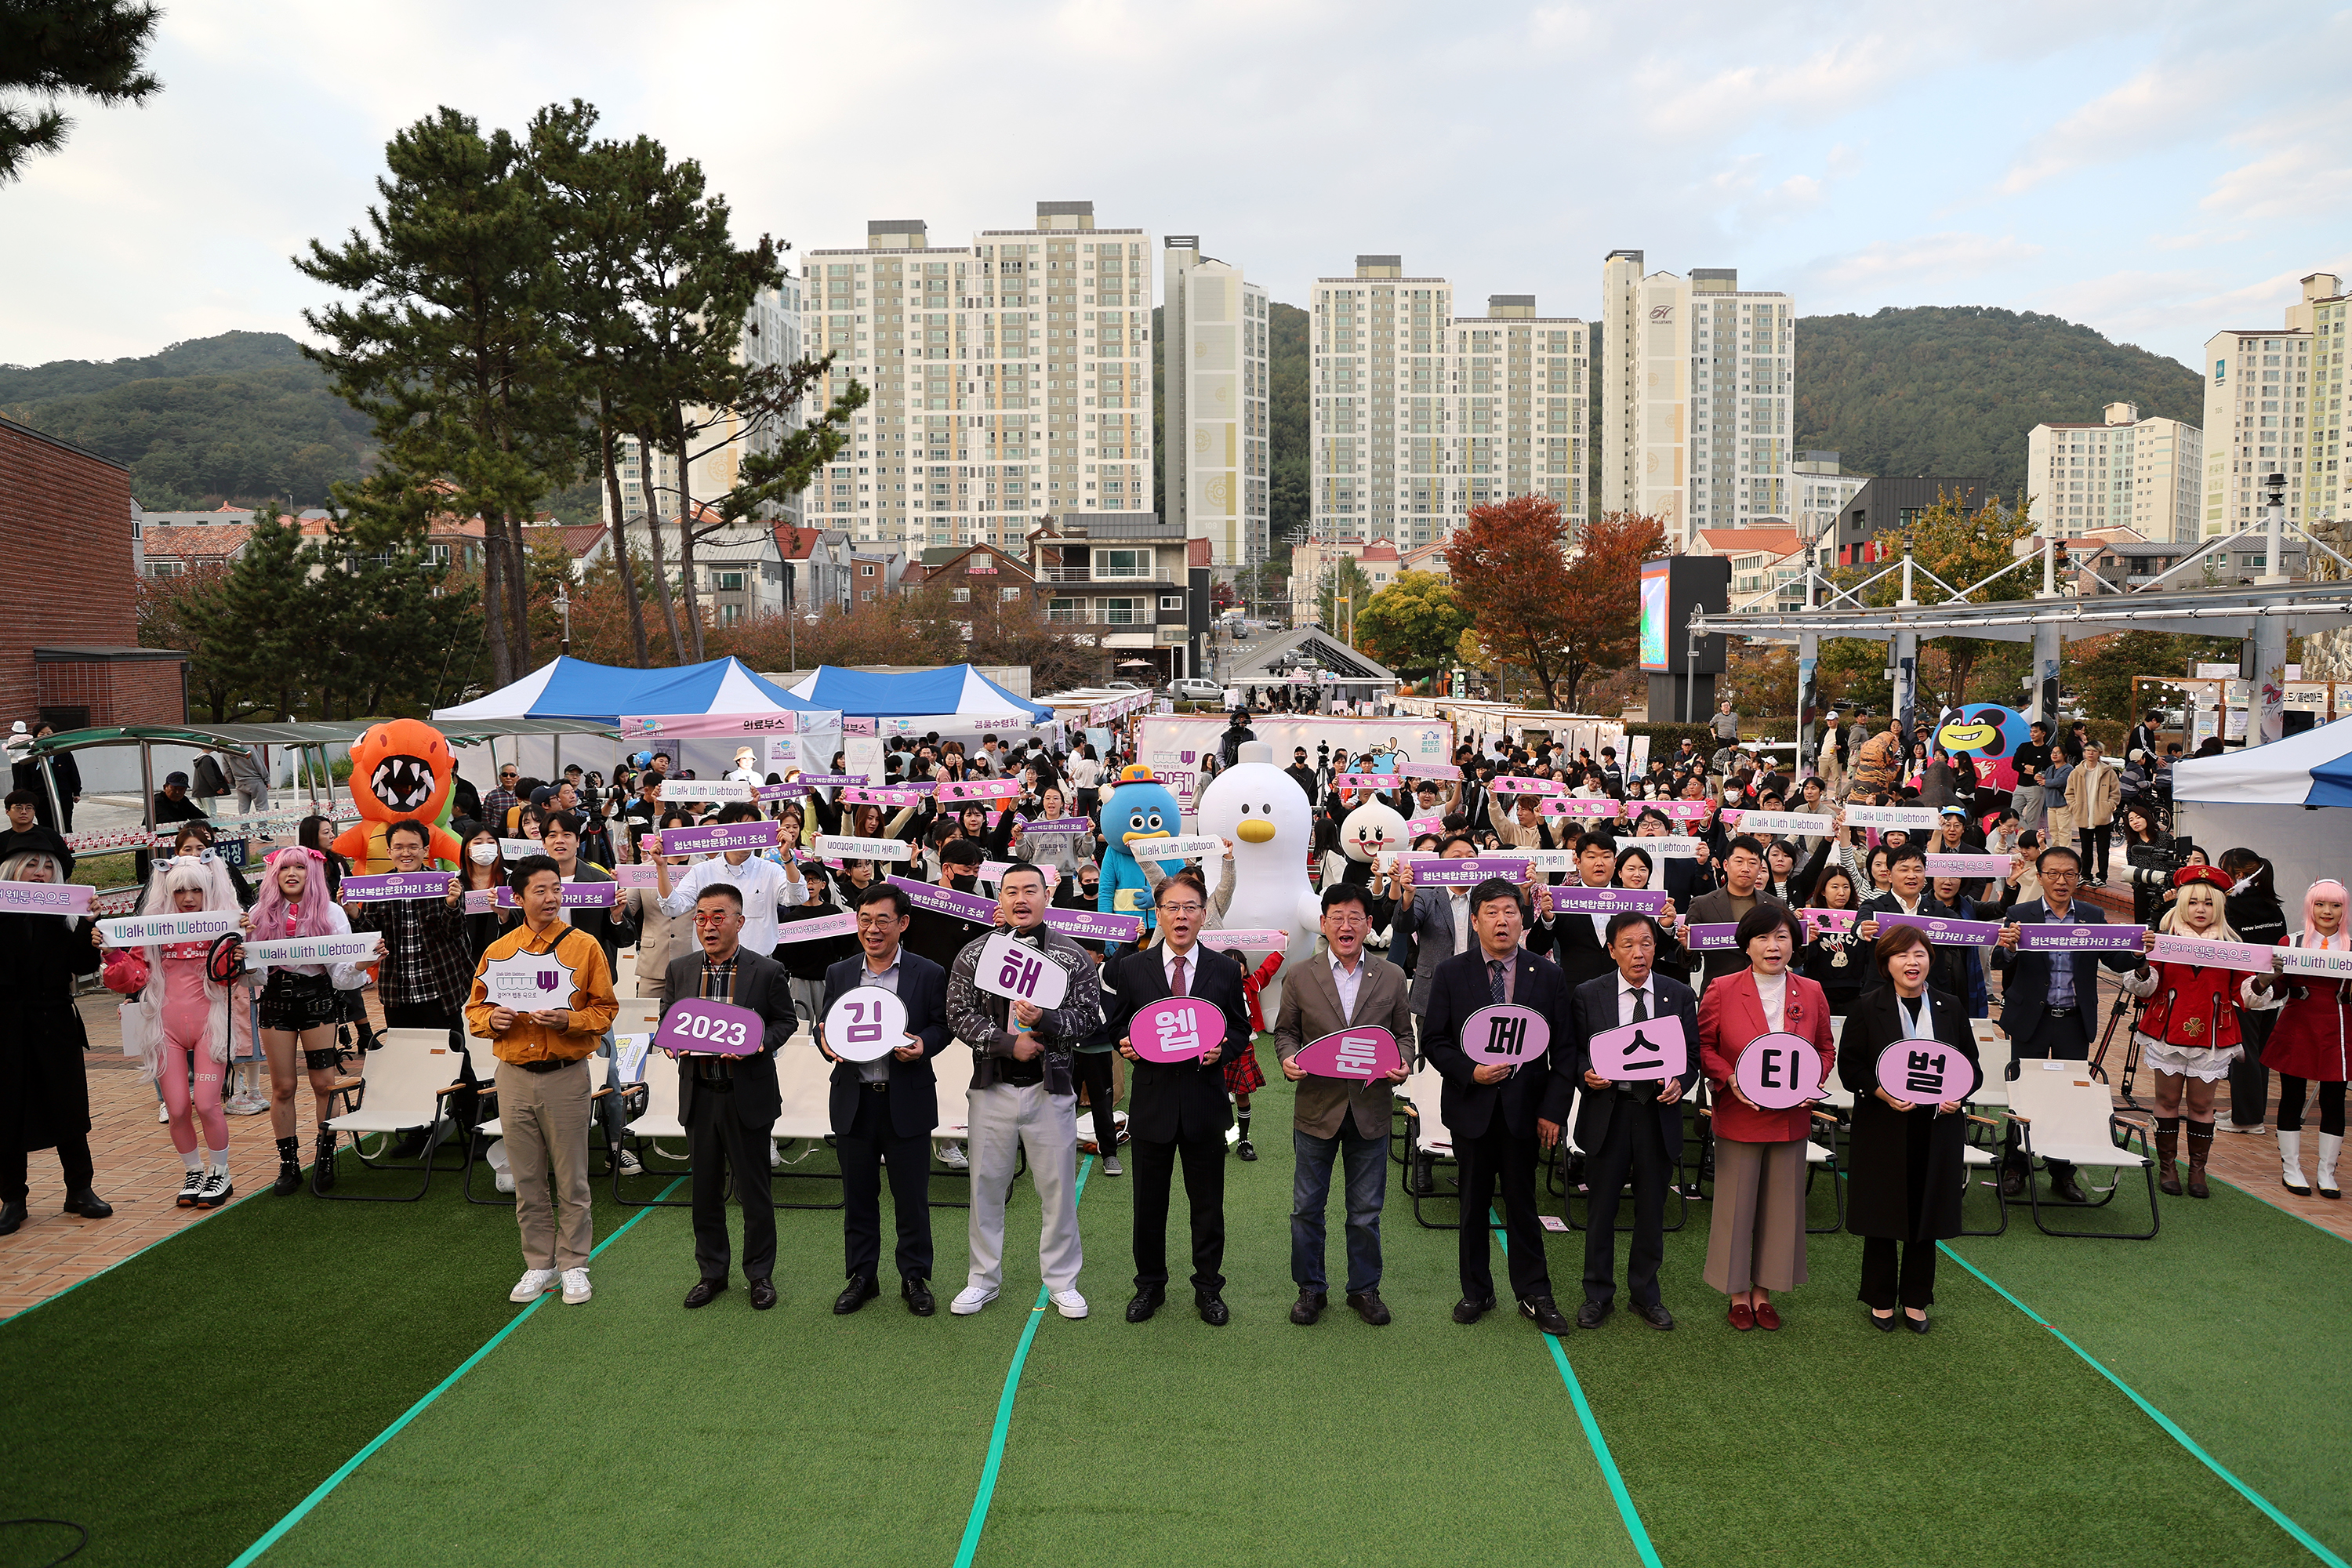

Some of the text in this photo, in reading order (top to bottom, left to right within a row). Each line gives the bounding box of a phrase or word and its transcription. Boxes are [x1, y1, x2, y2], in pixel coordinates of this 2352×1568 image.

[743, 719, 786, 730] 의료부스
[975, 718, 1018, 729] 경품수령처
[1132, 771, 1145, 779] W
[669, 786, 742, 797] Walk With Webtoon
[760, 789, 791, 799] 복합문화거리
[1749, 817, 1824, 830] Walk With Webtoon
[1855, 811, 1930, 823] Walk With Webtoon
[673, 833, 768, 850] 청년복합문화거리 조성
[827, 840, 901, 855] Walk With Webtoon
[1139, 840, 1215, 856] Walk With Webtoon
[1639, 842, 1657, 852] With
[1658, 842, 1690, 853] Webtoon
[215, 843, 241, 864] 차장
[503, 844, 549, 855] With Webto
[1546, 855, 1565, 866] Walk
[1947, 860, 1966, 872] 웹툰
[1967, 860, 1994, 872] 속으로
[1422, 871, 1519, 882] 청년복합문화거리 조성
[5, 889, 71, 906] 웹툰 속으로
[346, 883, 443, 898] 청년복합문화거리 조성
[585, 895, 603, 904] 조성
[1560, 899, 1653, 912] 청년복합문화거리 조성
[967, 906, 985, 919] 조성
[114, 920, 228, 939] Walk With Webtoon
[803, 924, 821, 935] 웹툰
[821, 920, 848, 933] 속으로
[1108, 926, 1127, 937] 조성
[1222, 935, 1240, 945] 웹툰
[1241, 935, 1269, 945] 속으로
[1702, 935, 1737, 946] 청년복합
[1925, 929, 1986, 943] 문화거리 조성
[2030, 936, 2131, 947] 청년복합문화거리 조성
[260, 942, 365, 960] Walk With Webtoon
[2159, 942, 2252, 963] 걸어서 웹툰 속으로
[2300, 955, 2325, 969] With
[998, 948, 1043, 999] 해
[844, 1000, 882, 1043] 김
[673, 1011, 748, 1047] 2023
[1155, 1007, 1200, 1053] 웹
[1484, 1016, 1527, 1056] 페
[1334, 1036, 1377, 1076] 툰
[1622, 1029, 1664, 1072] 스
[1761, 1048, 1800, 1091] 티
[1905, 1050, 1947, 1094] 벌
